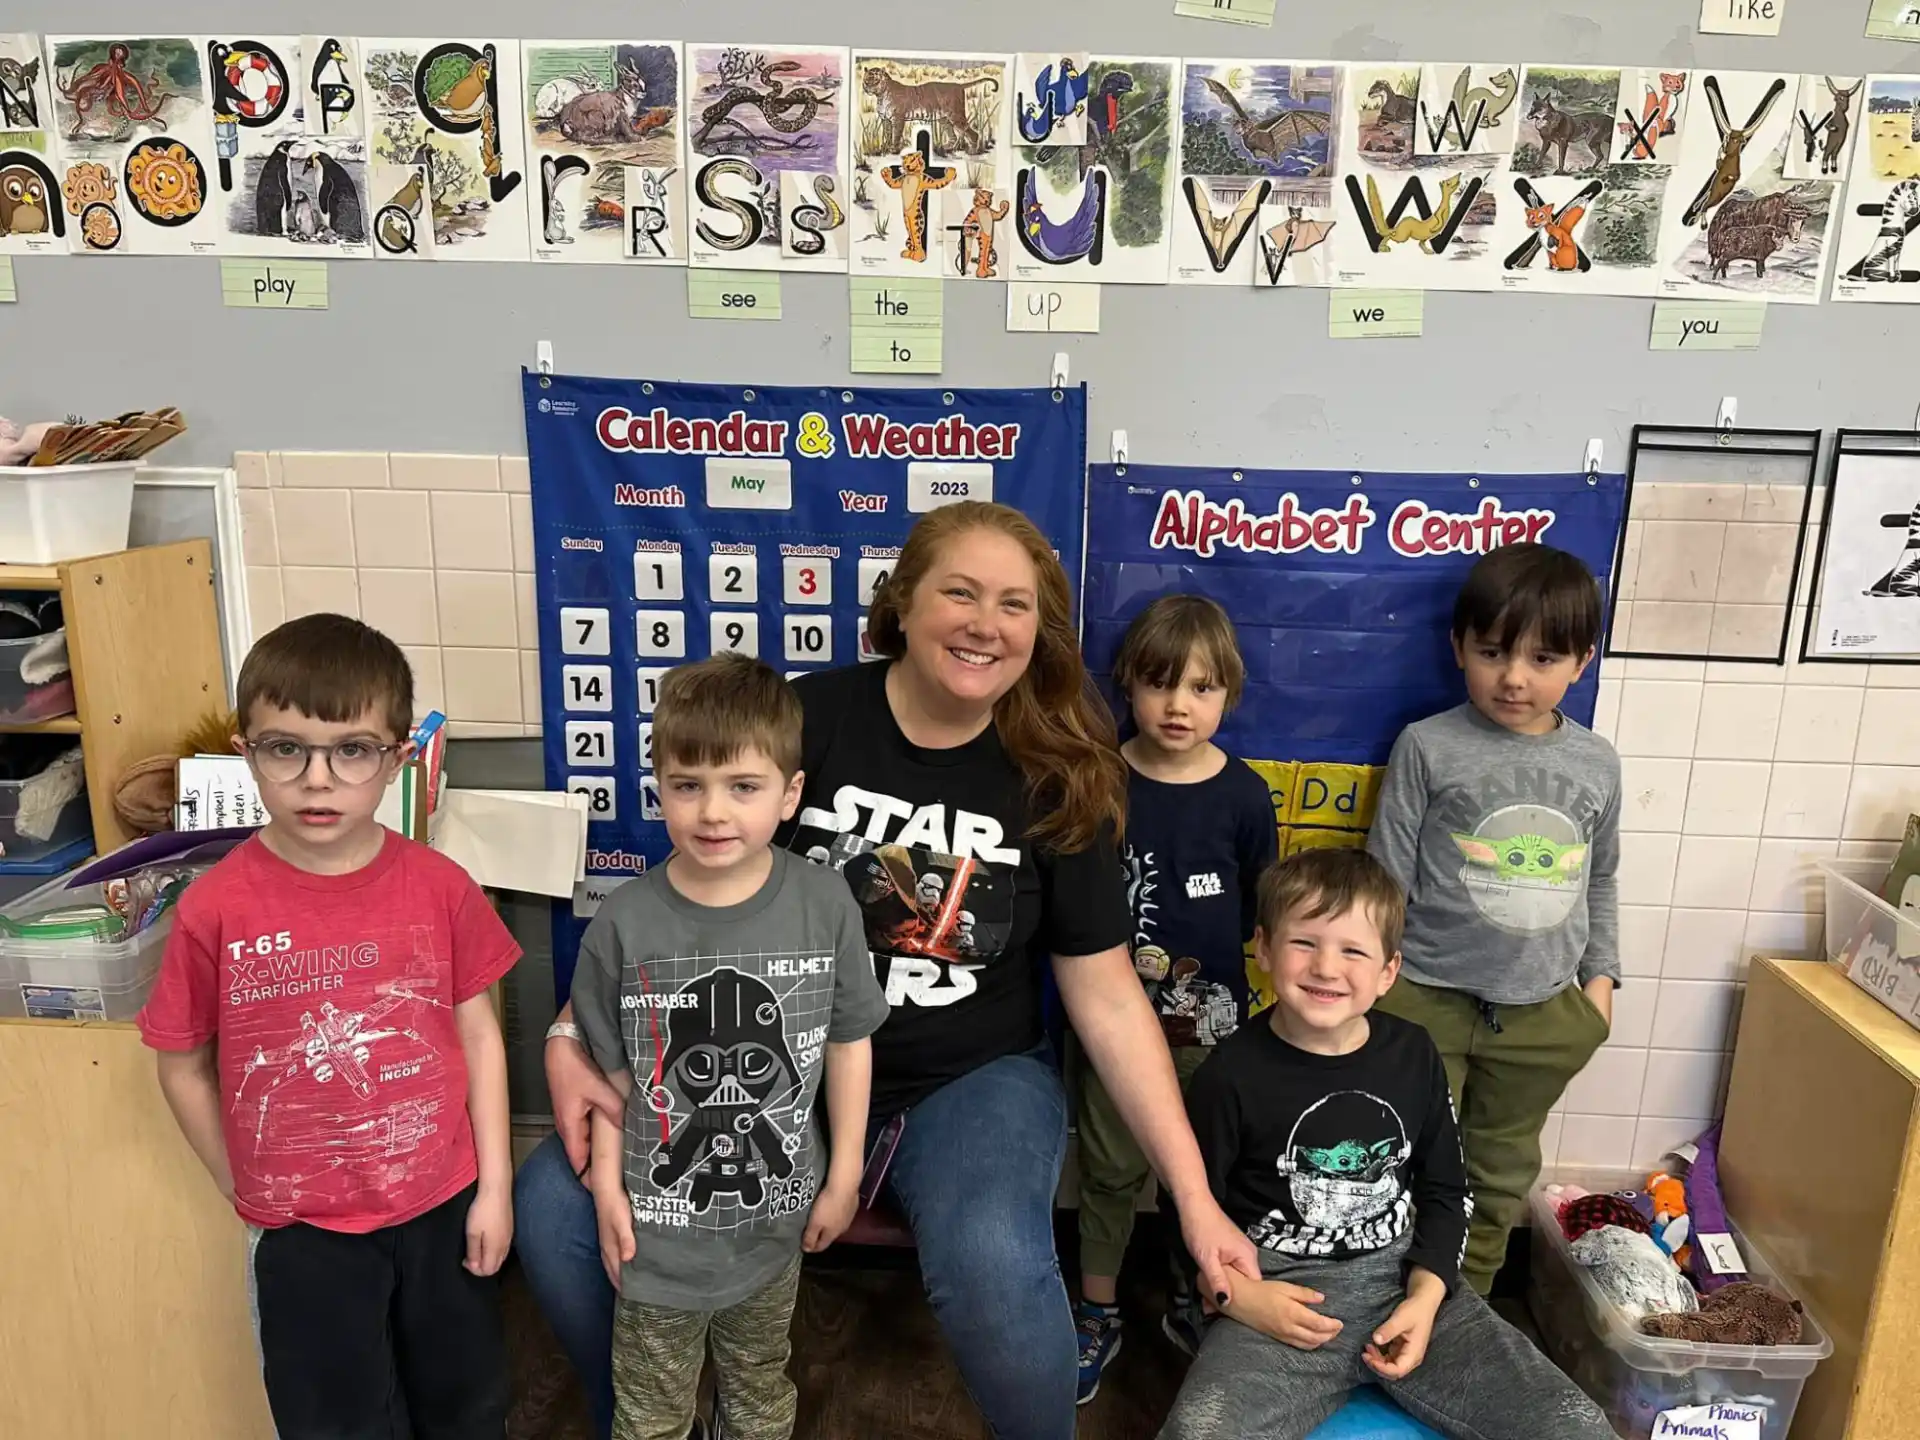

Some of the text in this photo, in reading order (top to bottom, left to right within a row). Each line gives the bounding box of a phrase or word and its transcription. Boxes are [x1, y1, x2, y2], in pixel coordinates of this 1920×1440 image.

[320, 82, 355, 133] P
[374, 203, 416, 254] Q
[631, 205, 666, 256] R
[254, 267, 296, 304] play
[721, 291, 756, 309] see
[875, 291, 909, 317] the
[1026, 290, 1063, 331] up
[1352, 305, 1385, 324] we
[1679, 316, 1720, 347] you
[890, 341, 911, 364] to
[596, 406, 1020, 460] Calendar & Weather
[613, 482, 686, 510] Month
[730, 474, 766, 494] May
[930, 481, 969, 498] 2023
[839, 489, 888, 514] Year
[1150, 490, 1555, 557] Alphabet Center
[561, 537, 903, 558] Sunday Monday Tuesday Wednesday Thursda
[652, 564, 817, 595] 1 2 3
[575, 619, 823, 652] 7 8 9 10
[570, 676, 603, 702] 14
[575, 732, 605, 758] 21
[800, 784, 1021, 867] STAR
[587, 849, 646, 874] Today
[1185, 882, 1222, 898] WARS
[1188, 872, 1220, 887] STAR
[227, 931, 292, 960] T-65
[229, 943, 380, 991] X-WING
[767, 957, 833, 977] HELMET
[885, 952, 986, 1007] RS
[1862, 956, 1900, 996] BIRD
[230, 975, 344, 1005] STARFIGHTER
[620, 993, 699, 1009] IGHTSABER
[797, 1024, 828, 1049] DARK
[379, 1065, 420, 1082] INCOM
[629, 1191, 696, 1214] E-SYSTEM
[769, 1188, 814, 1219] VADER
[633, 1208, 689, 1227] MPUTER
[1708, 1405, 1758, 1421] Phonics
